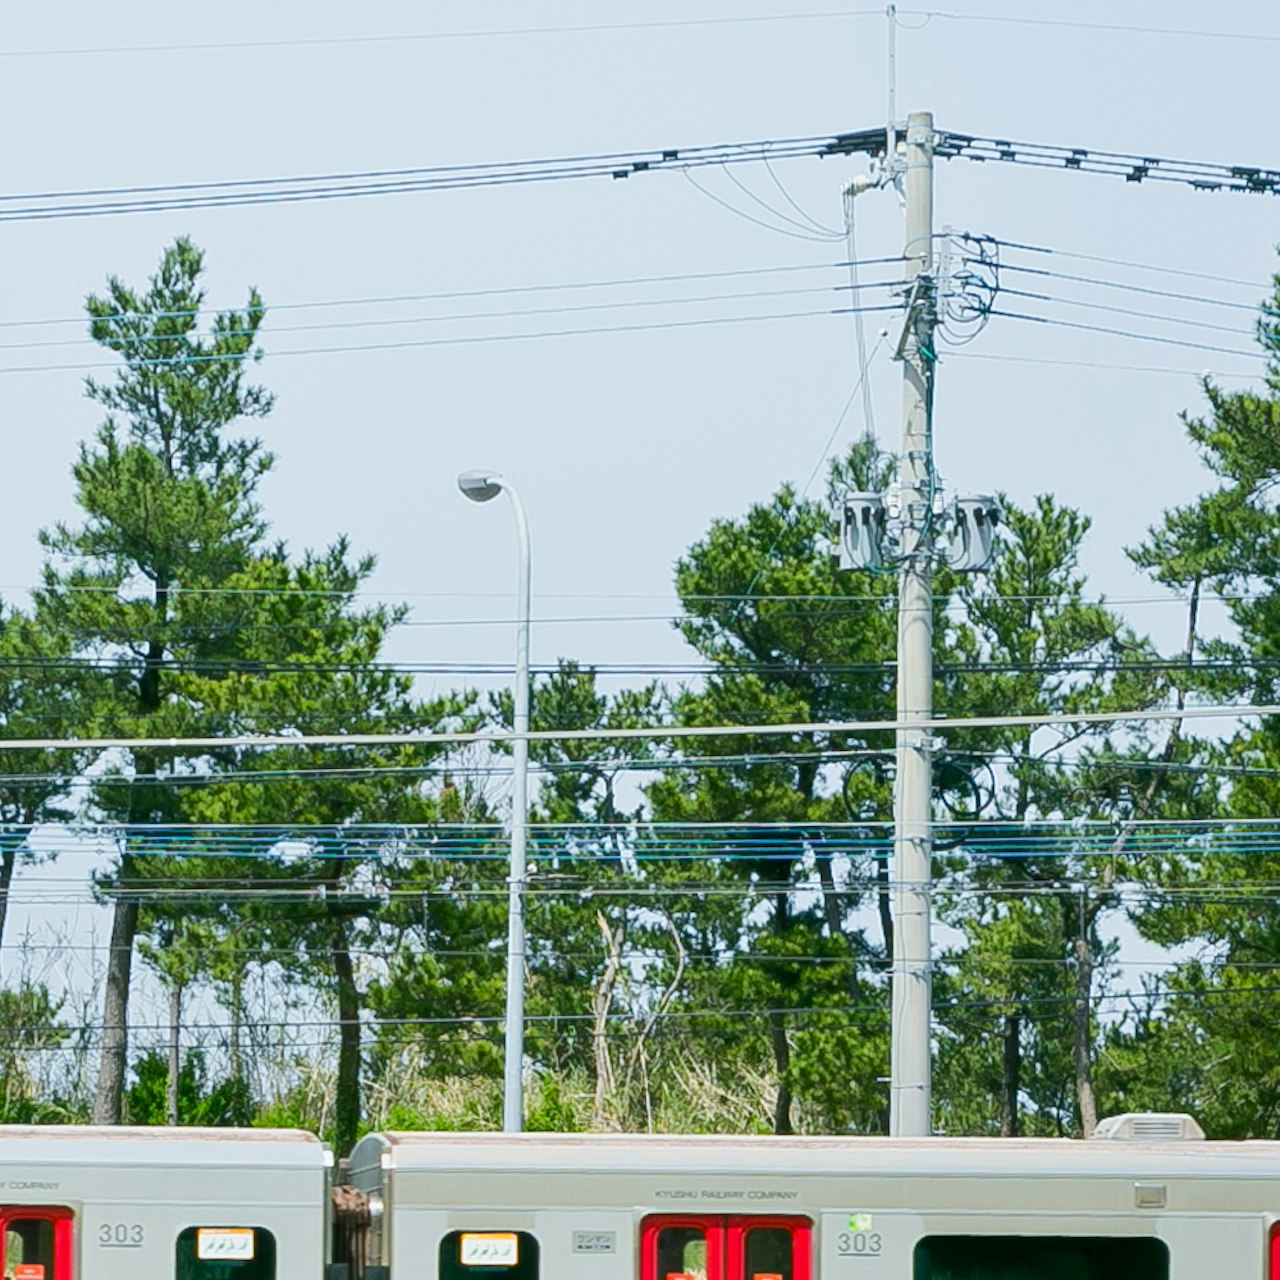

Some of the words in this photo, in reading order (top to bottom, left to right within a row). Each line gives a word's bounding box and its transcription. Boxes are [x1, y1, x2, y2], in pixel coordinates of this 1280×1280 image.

[8, 1180, 61, 1190] COMPANY
[655, 1190, 699, 1199] KYUSHU
[701, 1190, 745, 1199] RAILWAY
[747, 1190, 800, 1200] COMPANY
[98, 1223, 145, 1243] 303
[837, 1233, 883, 1253] 303
